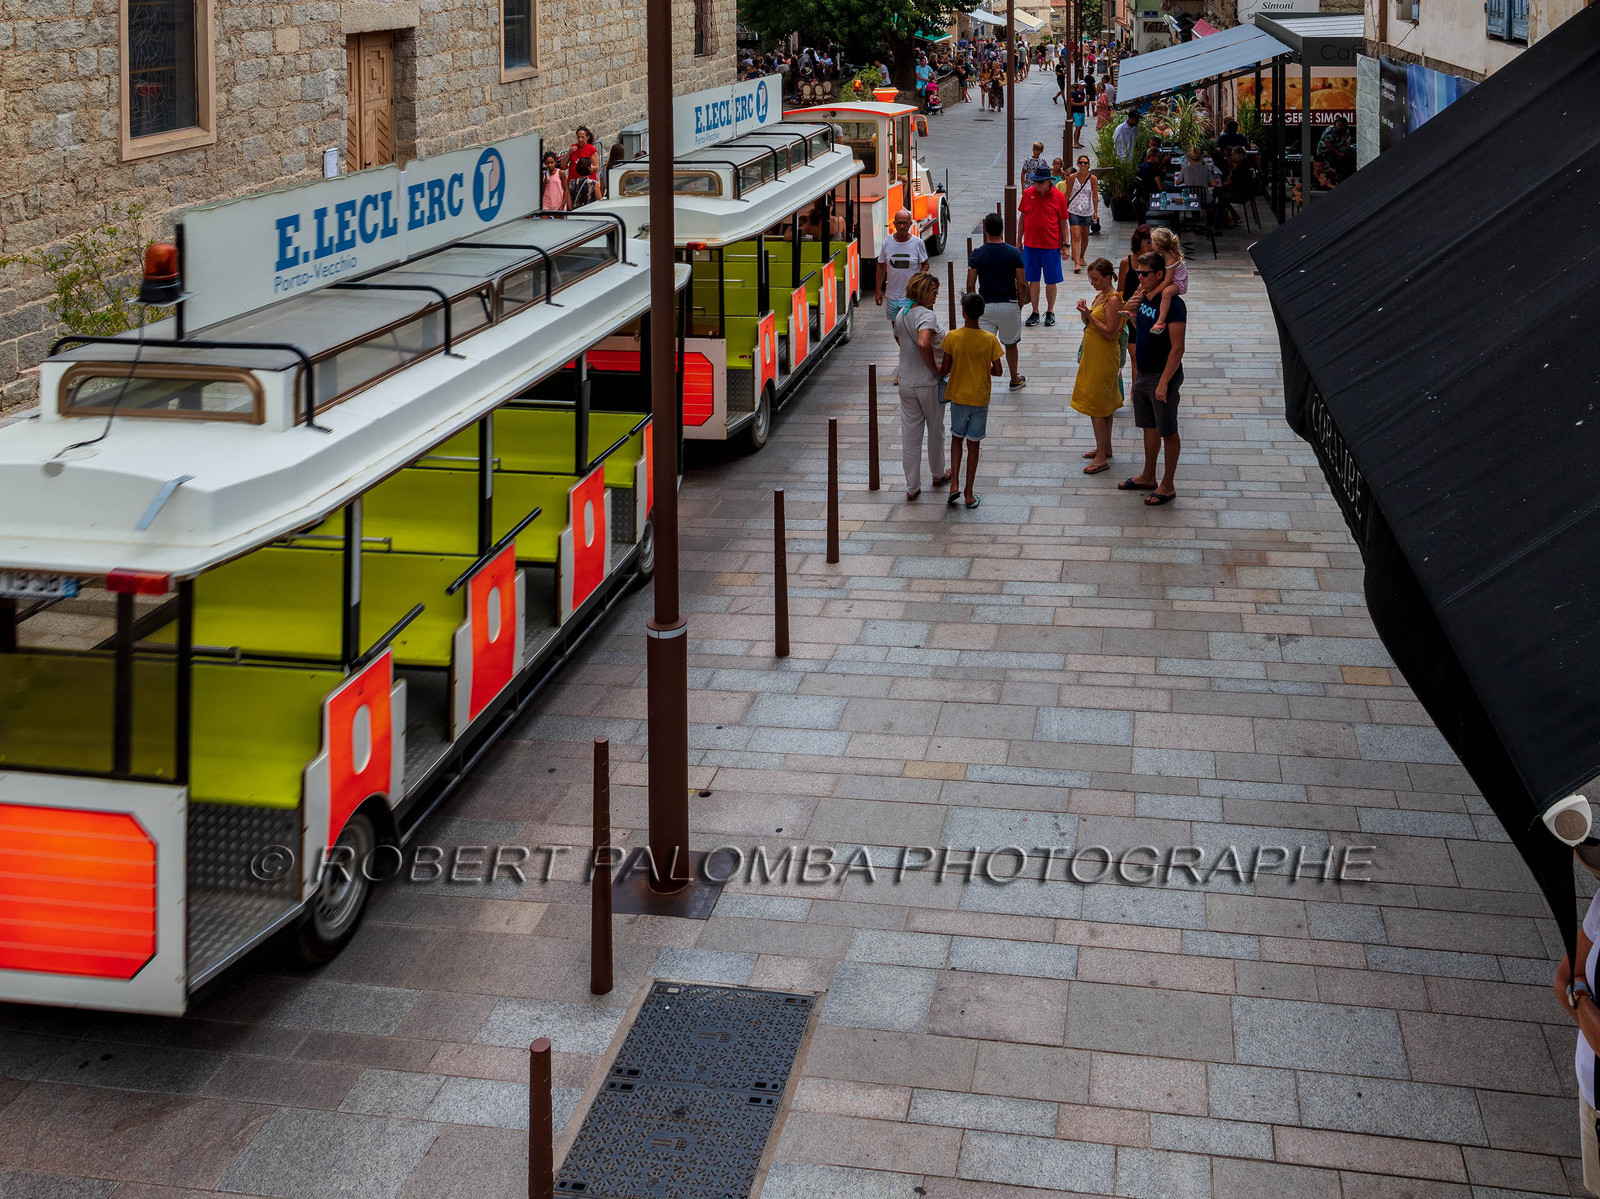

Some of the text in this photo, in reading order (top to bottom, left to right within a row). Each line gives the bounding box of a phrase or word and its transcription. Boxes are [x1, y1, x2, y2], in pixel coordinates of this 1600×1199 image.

[1262, 2, 1294, 10] Simoni
[1320, 43, 1359, 60] Caf
[1315, 112, 1353, 123] SIMONI
[274, 255, 358, 294] Porto-Vecchio
